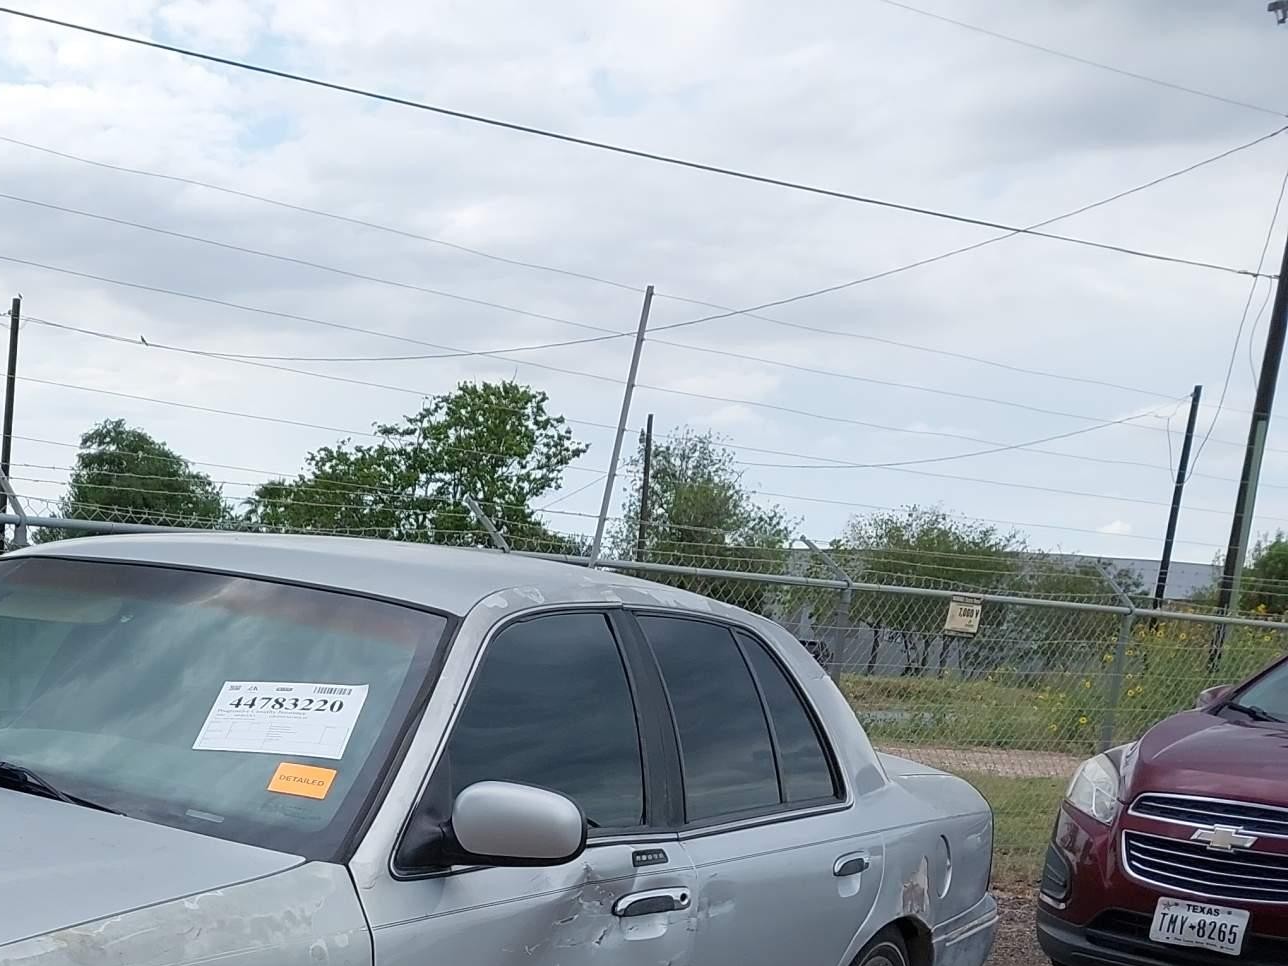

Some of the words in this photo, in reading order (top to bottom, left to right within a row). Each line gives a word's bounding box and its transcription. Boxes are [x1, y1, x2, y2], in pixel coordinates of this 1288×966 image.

[229, 696, 344, 713] 44783220
[278, 774, 325, 787] DETAILED
[1186, 903, 1221, 917] TEXAS
[1158, 912, 1188, 936] TMY
[1196, 918, 1239, 945] 8265
